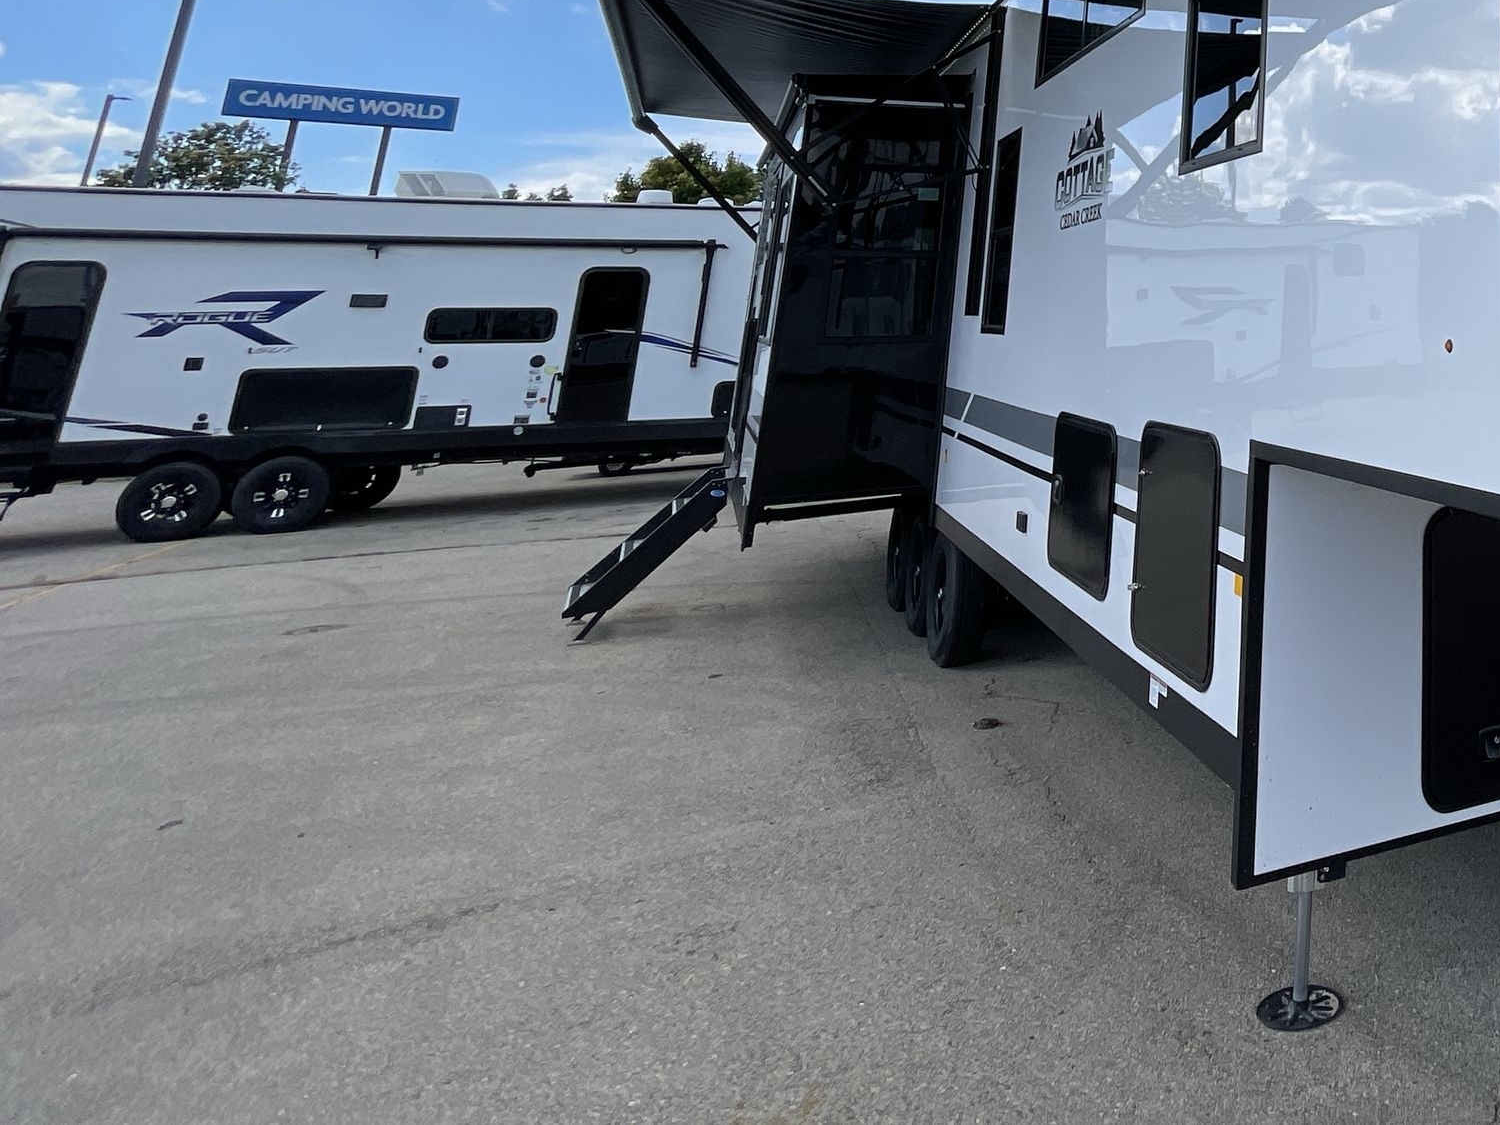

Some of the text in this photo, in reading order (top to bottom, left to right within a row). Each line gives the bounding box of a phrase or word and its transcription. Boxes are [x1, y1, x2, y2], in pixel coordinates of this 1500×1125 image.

[239, 89, 446, 121] CAMPING WORLD
[1055, 147, 1115, 211] COTTAGE
[1060, 202, 1102, 230] CEDAR CREEK
[151, 311, 274, 326] ROGUE
